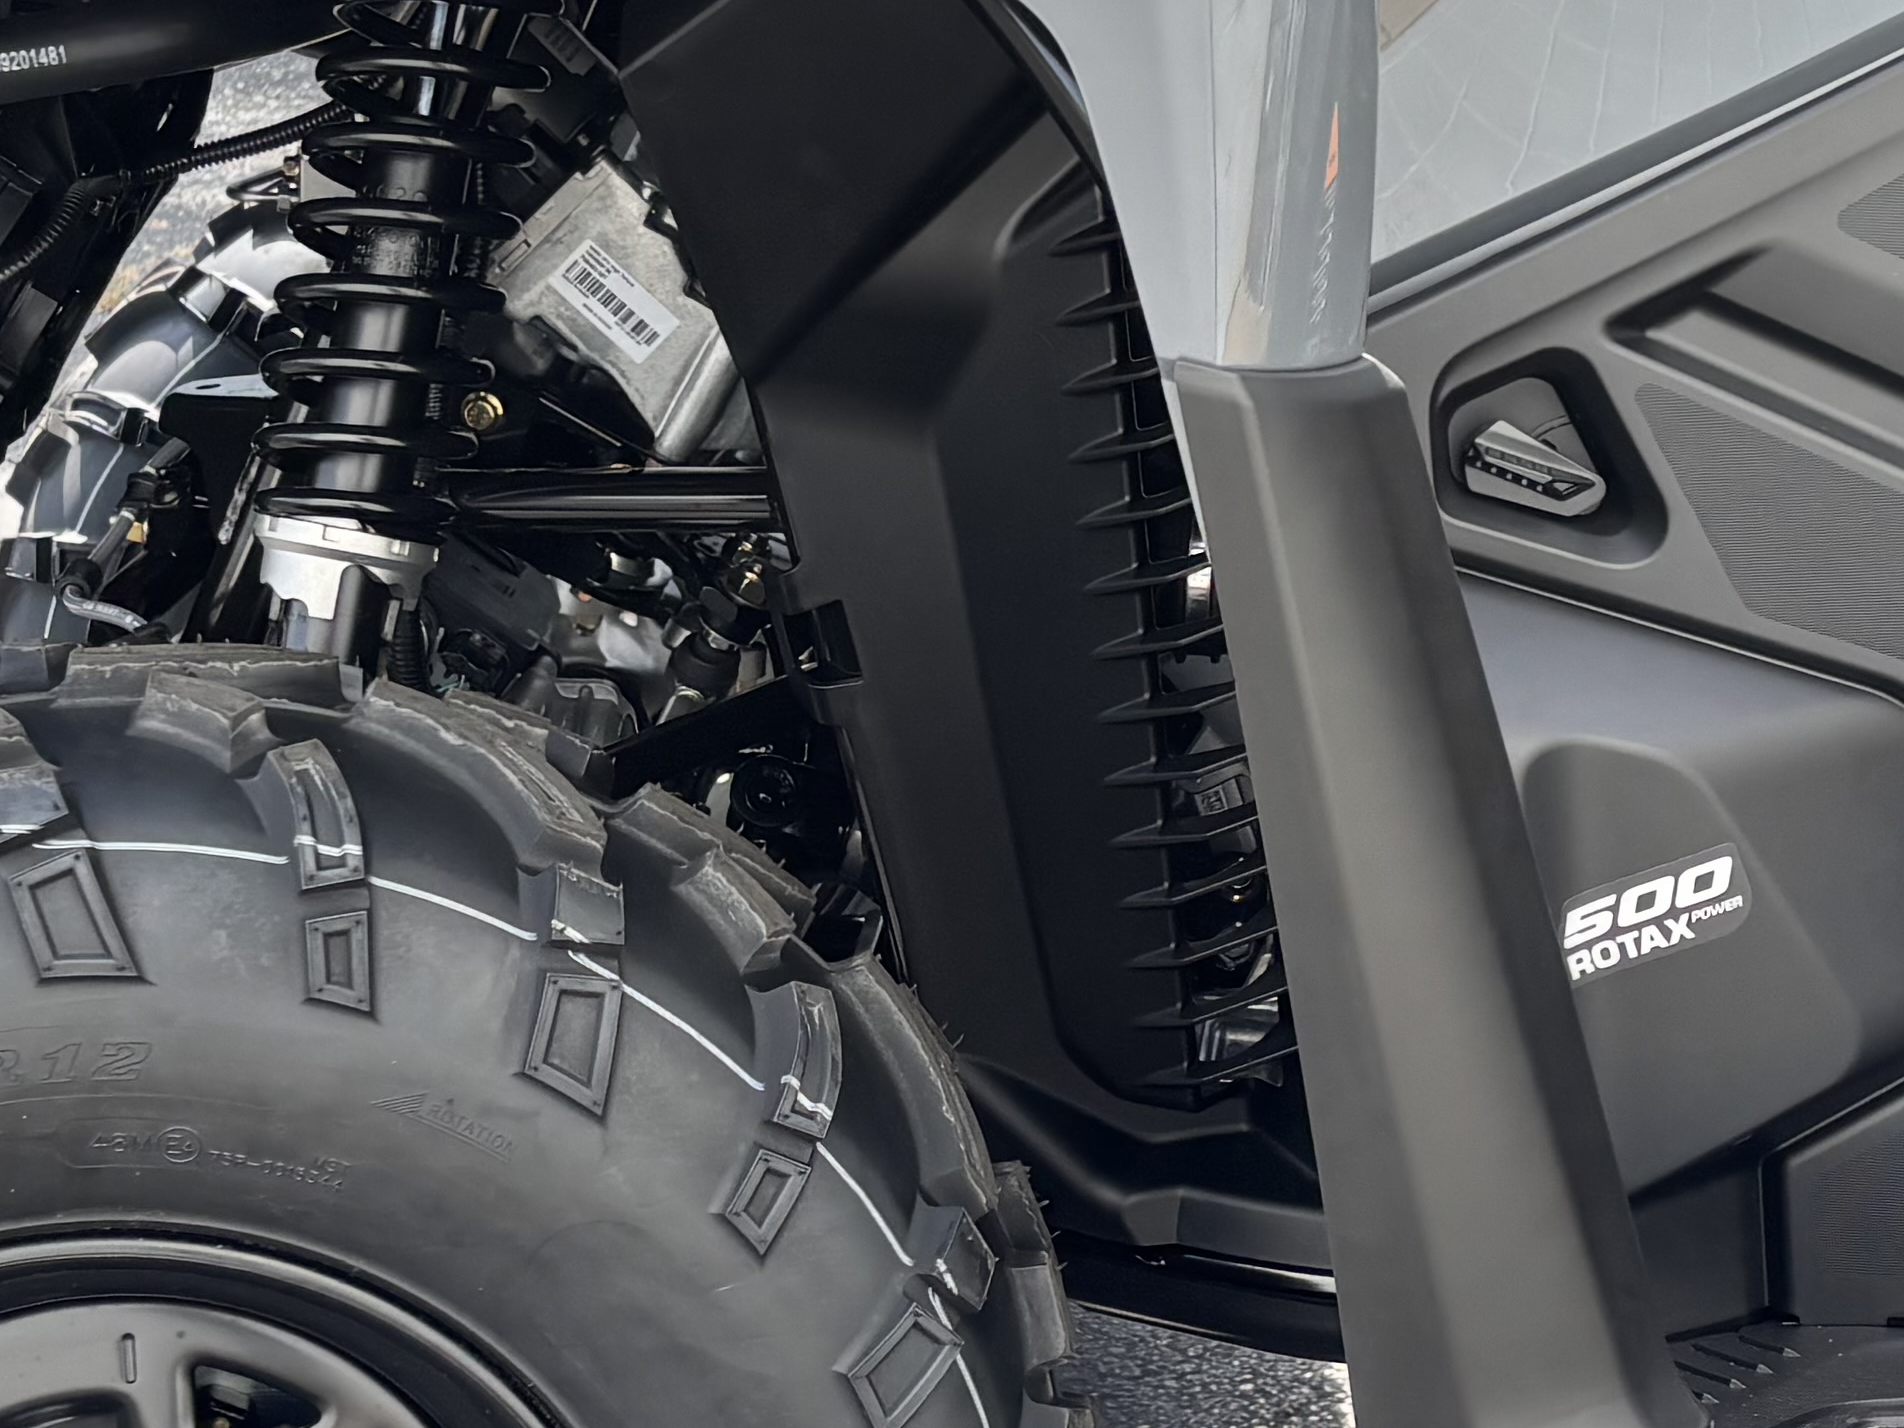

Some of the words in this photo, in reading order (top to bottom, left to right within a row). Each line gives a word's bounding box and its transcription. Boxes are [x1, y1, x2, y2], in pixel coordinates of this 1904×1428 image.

[1563, 855, 1734, 950] 500
[1566, 912, 1696, 981] ROTAX
[1690, 894, 1744, 924] POWER
